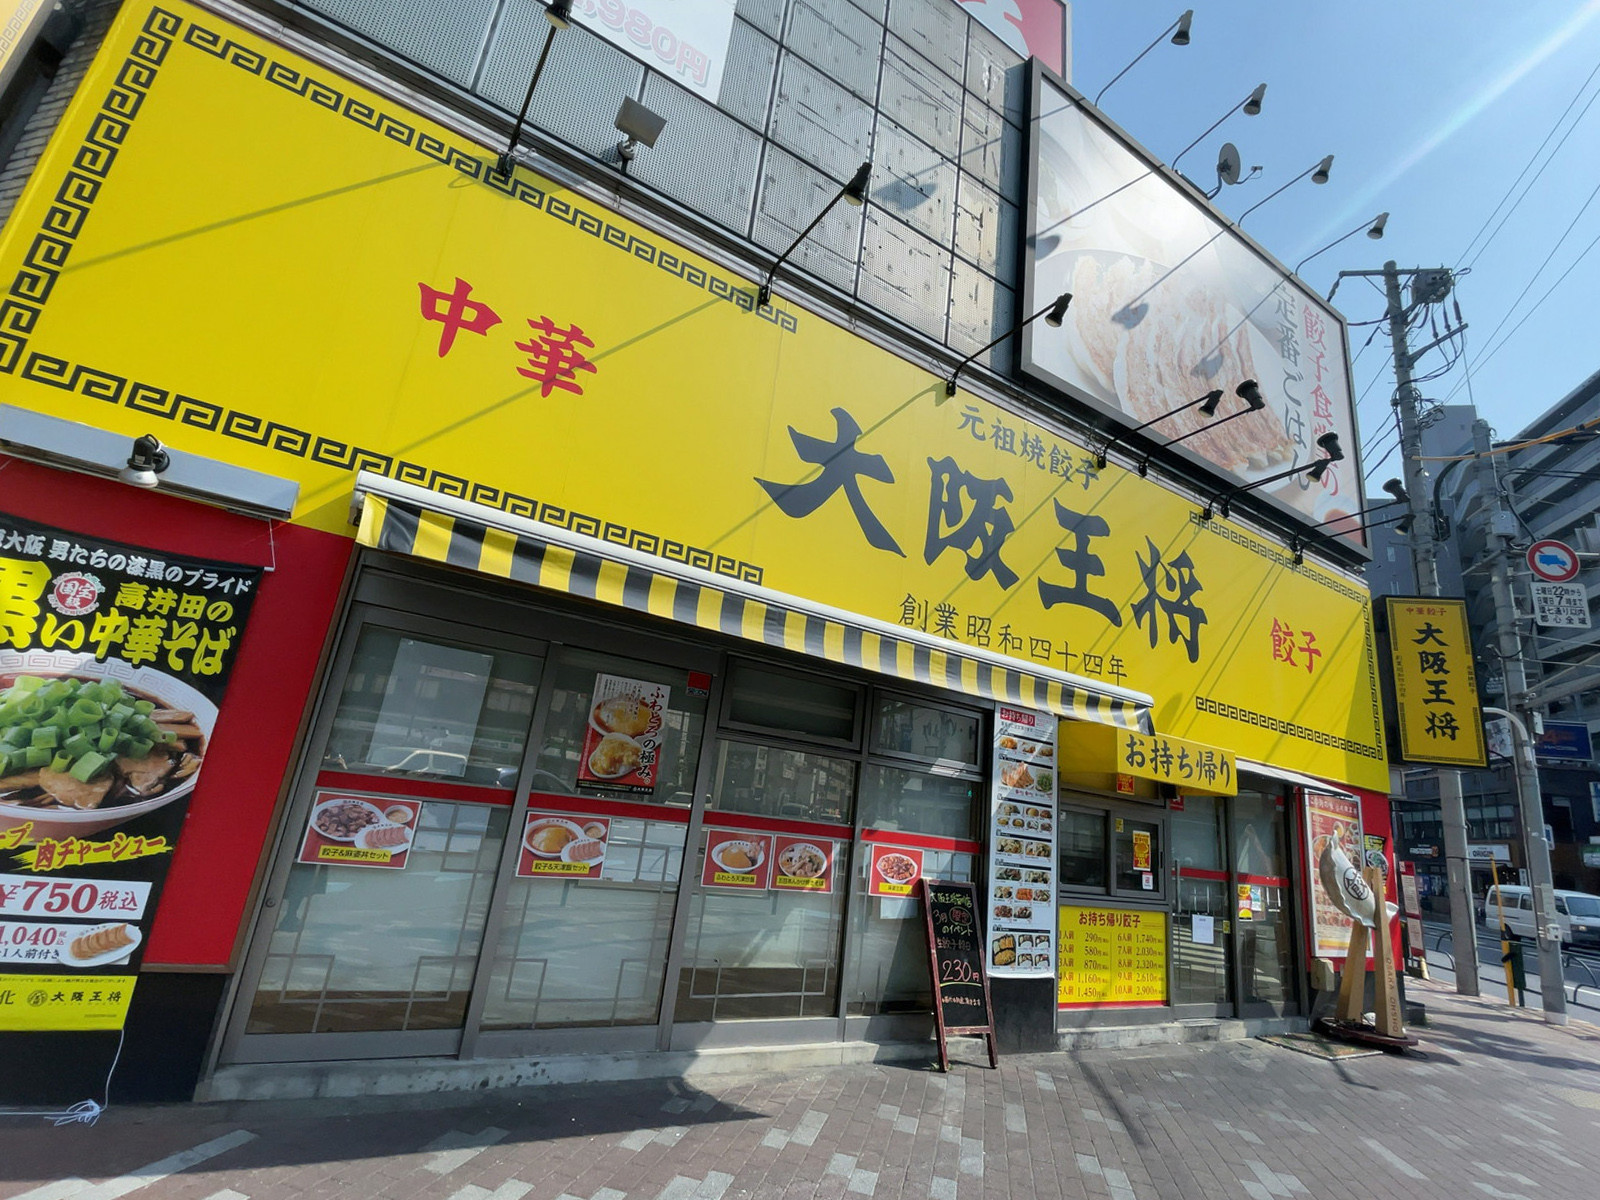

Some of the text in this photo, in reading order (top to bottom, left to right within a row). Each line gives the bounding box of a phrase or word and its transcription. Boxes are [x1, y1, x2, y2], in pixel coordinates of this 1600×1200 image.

[418, 277, 598, 398] 中華
[958, 405, 1099, 490] 元祖焼餃子
[753, 407, 1208, 664] 大阪王将
[48, 538, 254, 596] 男たちの漆黒のプライド
[115, 582, 234, 623] 高井田の
[898, 593, 1128, 687] 創業昭和四十四年
[1270, 616, 1322, 674] 餃子
[1412, 622, 1461, 741] 大阪王将
[1125, 734, 1231, 789] お持ち帰り
[34, 833, 166, 870] 肉チャーシュー
[1078, 911, 1141, 928] お持ち帰り餃子
[0, 948, 59, 960] 1人前付き
[942, 959, 979, 982] 230円
[51, 990, 122, 1003] 大阪王将
